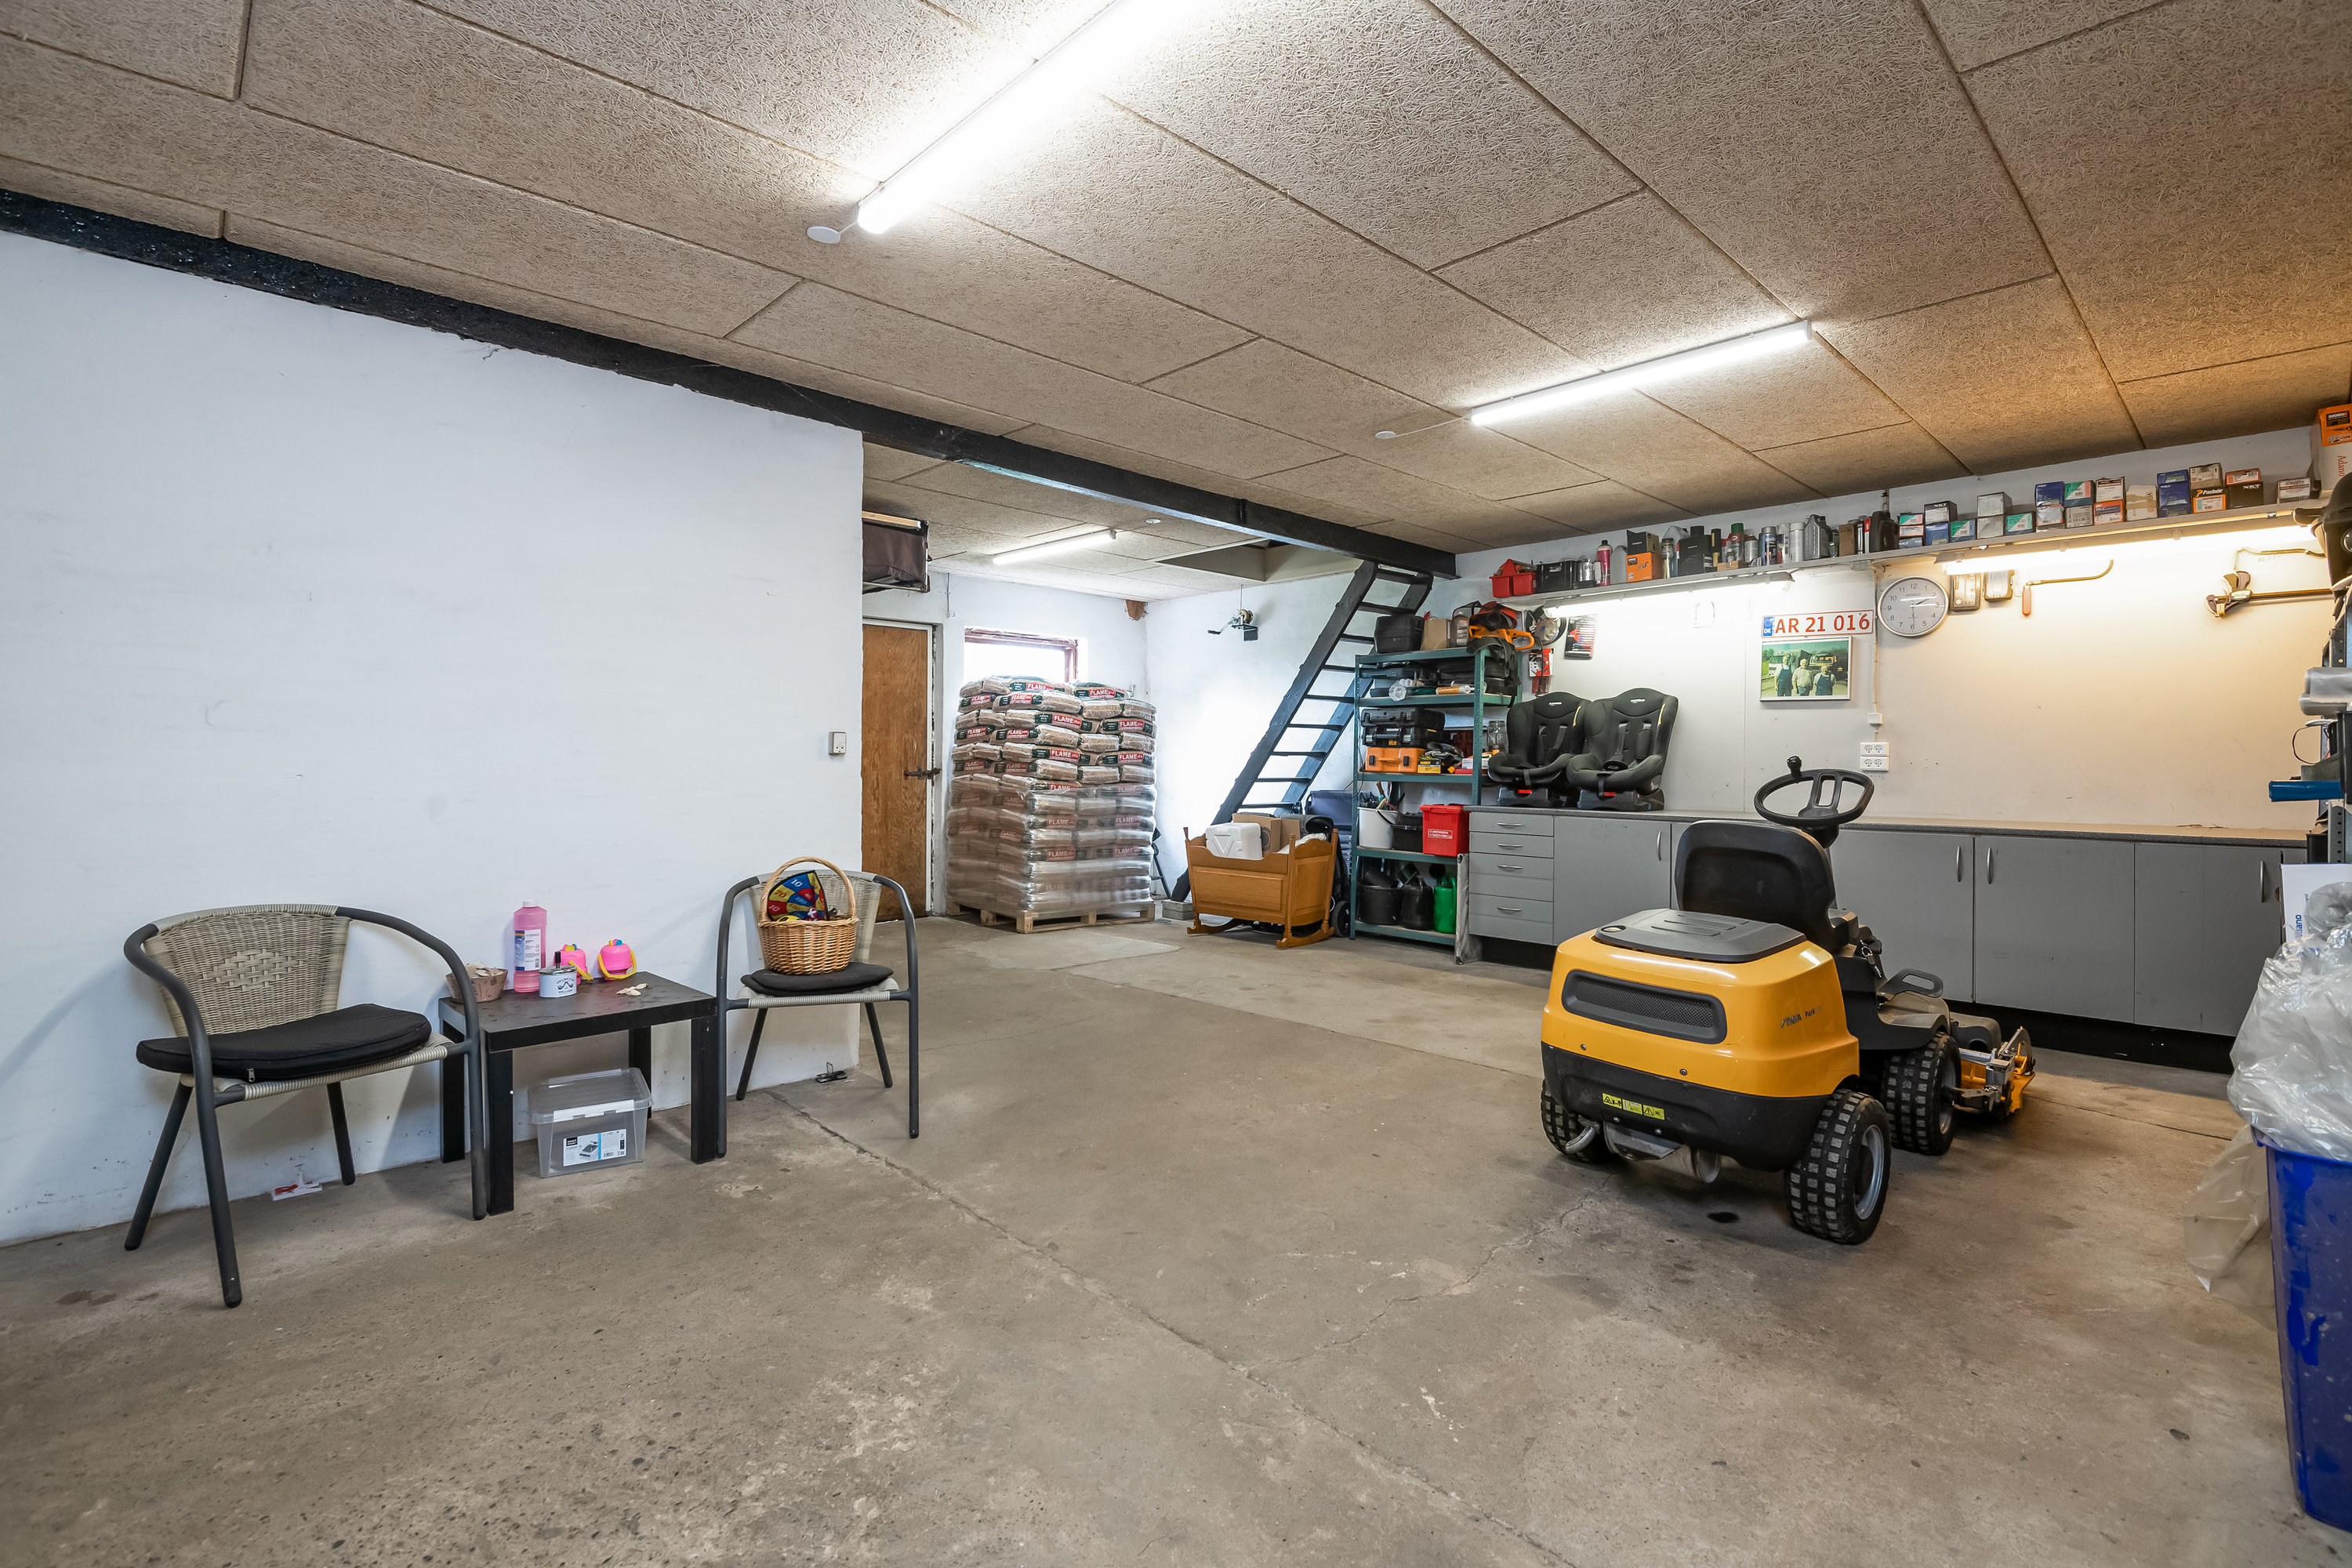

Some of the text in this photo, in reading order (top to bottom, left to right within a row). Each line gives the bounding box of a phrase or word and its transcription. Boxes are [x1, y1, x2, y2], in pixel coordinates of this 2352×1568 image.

[1775, 618, 1799, 633] AR
[1805, 616, 1826, 633] 21
[1834, 613, 1870, 631] 016
[774, 890, 787, 898] 70
[1805, 1008, 1816, 1018] Park
